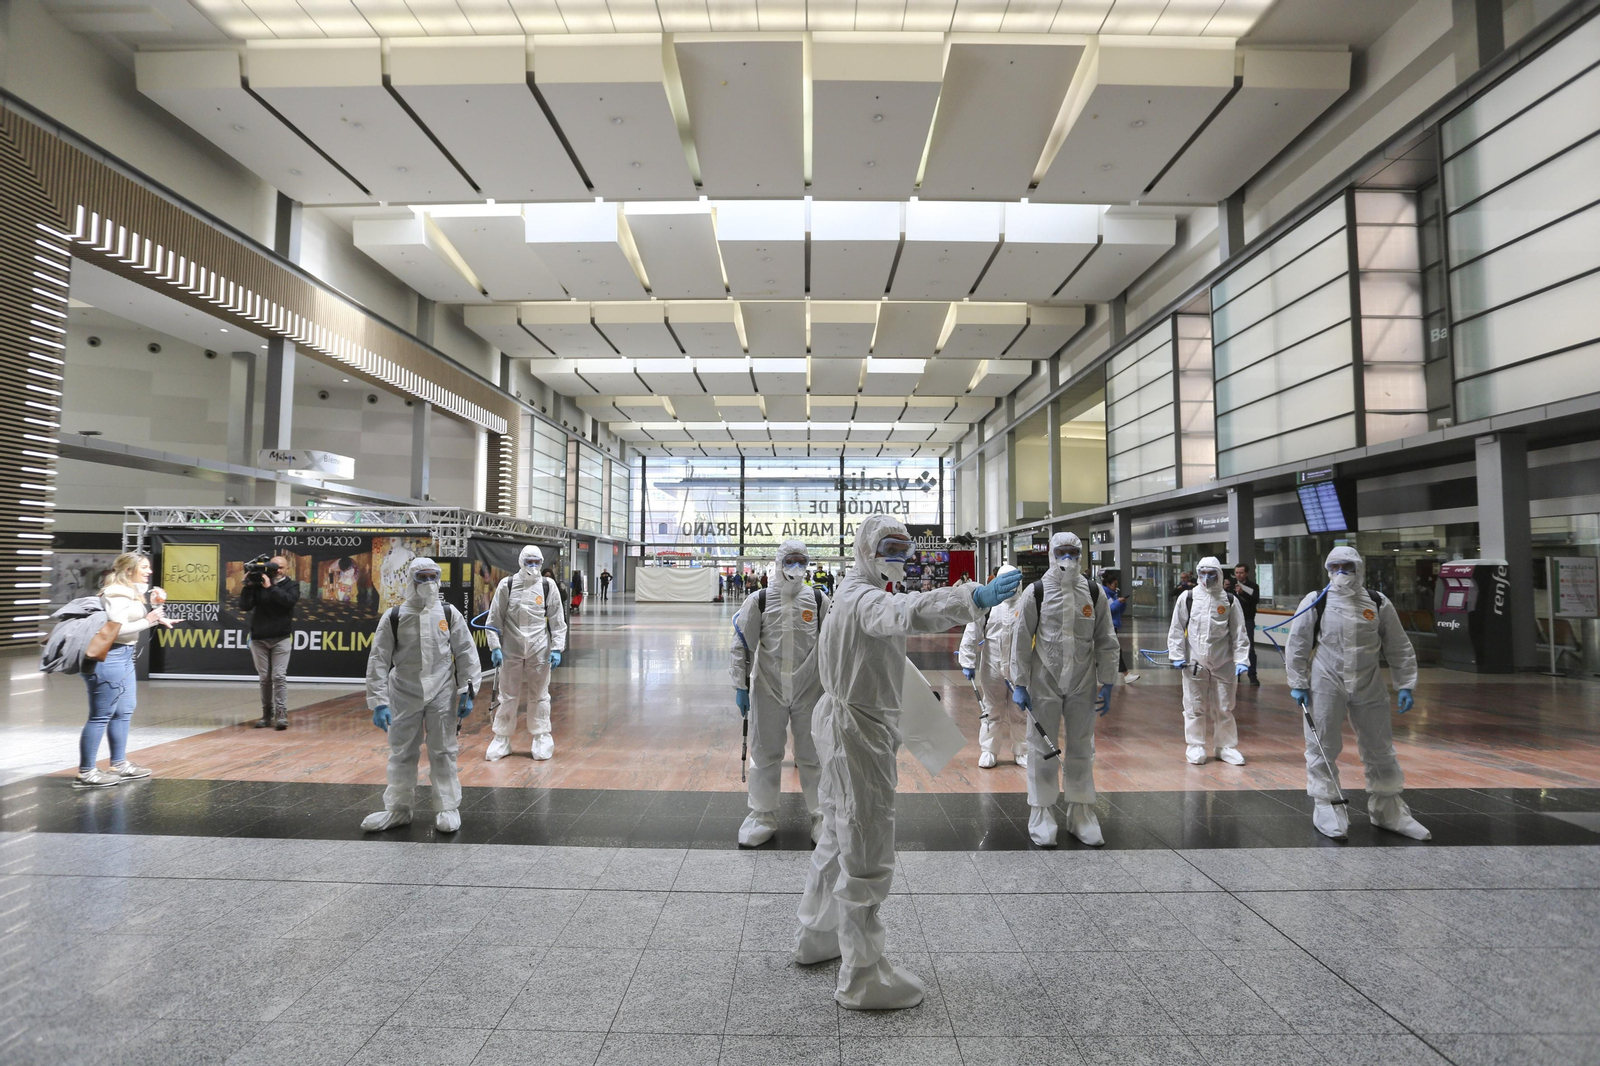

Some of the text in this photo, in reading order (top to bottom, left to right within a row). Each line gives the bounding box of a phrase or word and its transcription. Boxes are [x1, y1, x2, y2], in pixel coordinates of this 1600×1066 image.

[307, 536, 362, 547] 19.04.2020
[171, 563, 210, 573] EL ORO
[1492, 565, 1510, 615] renfe
[1437, 619, 1461, 630] renfe
